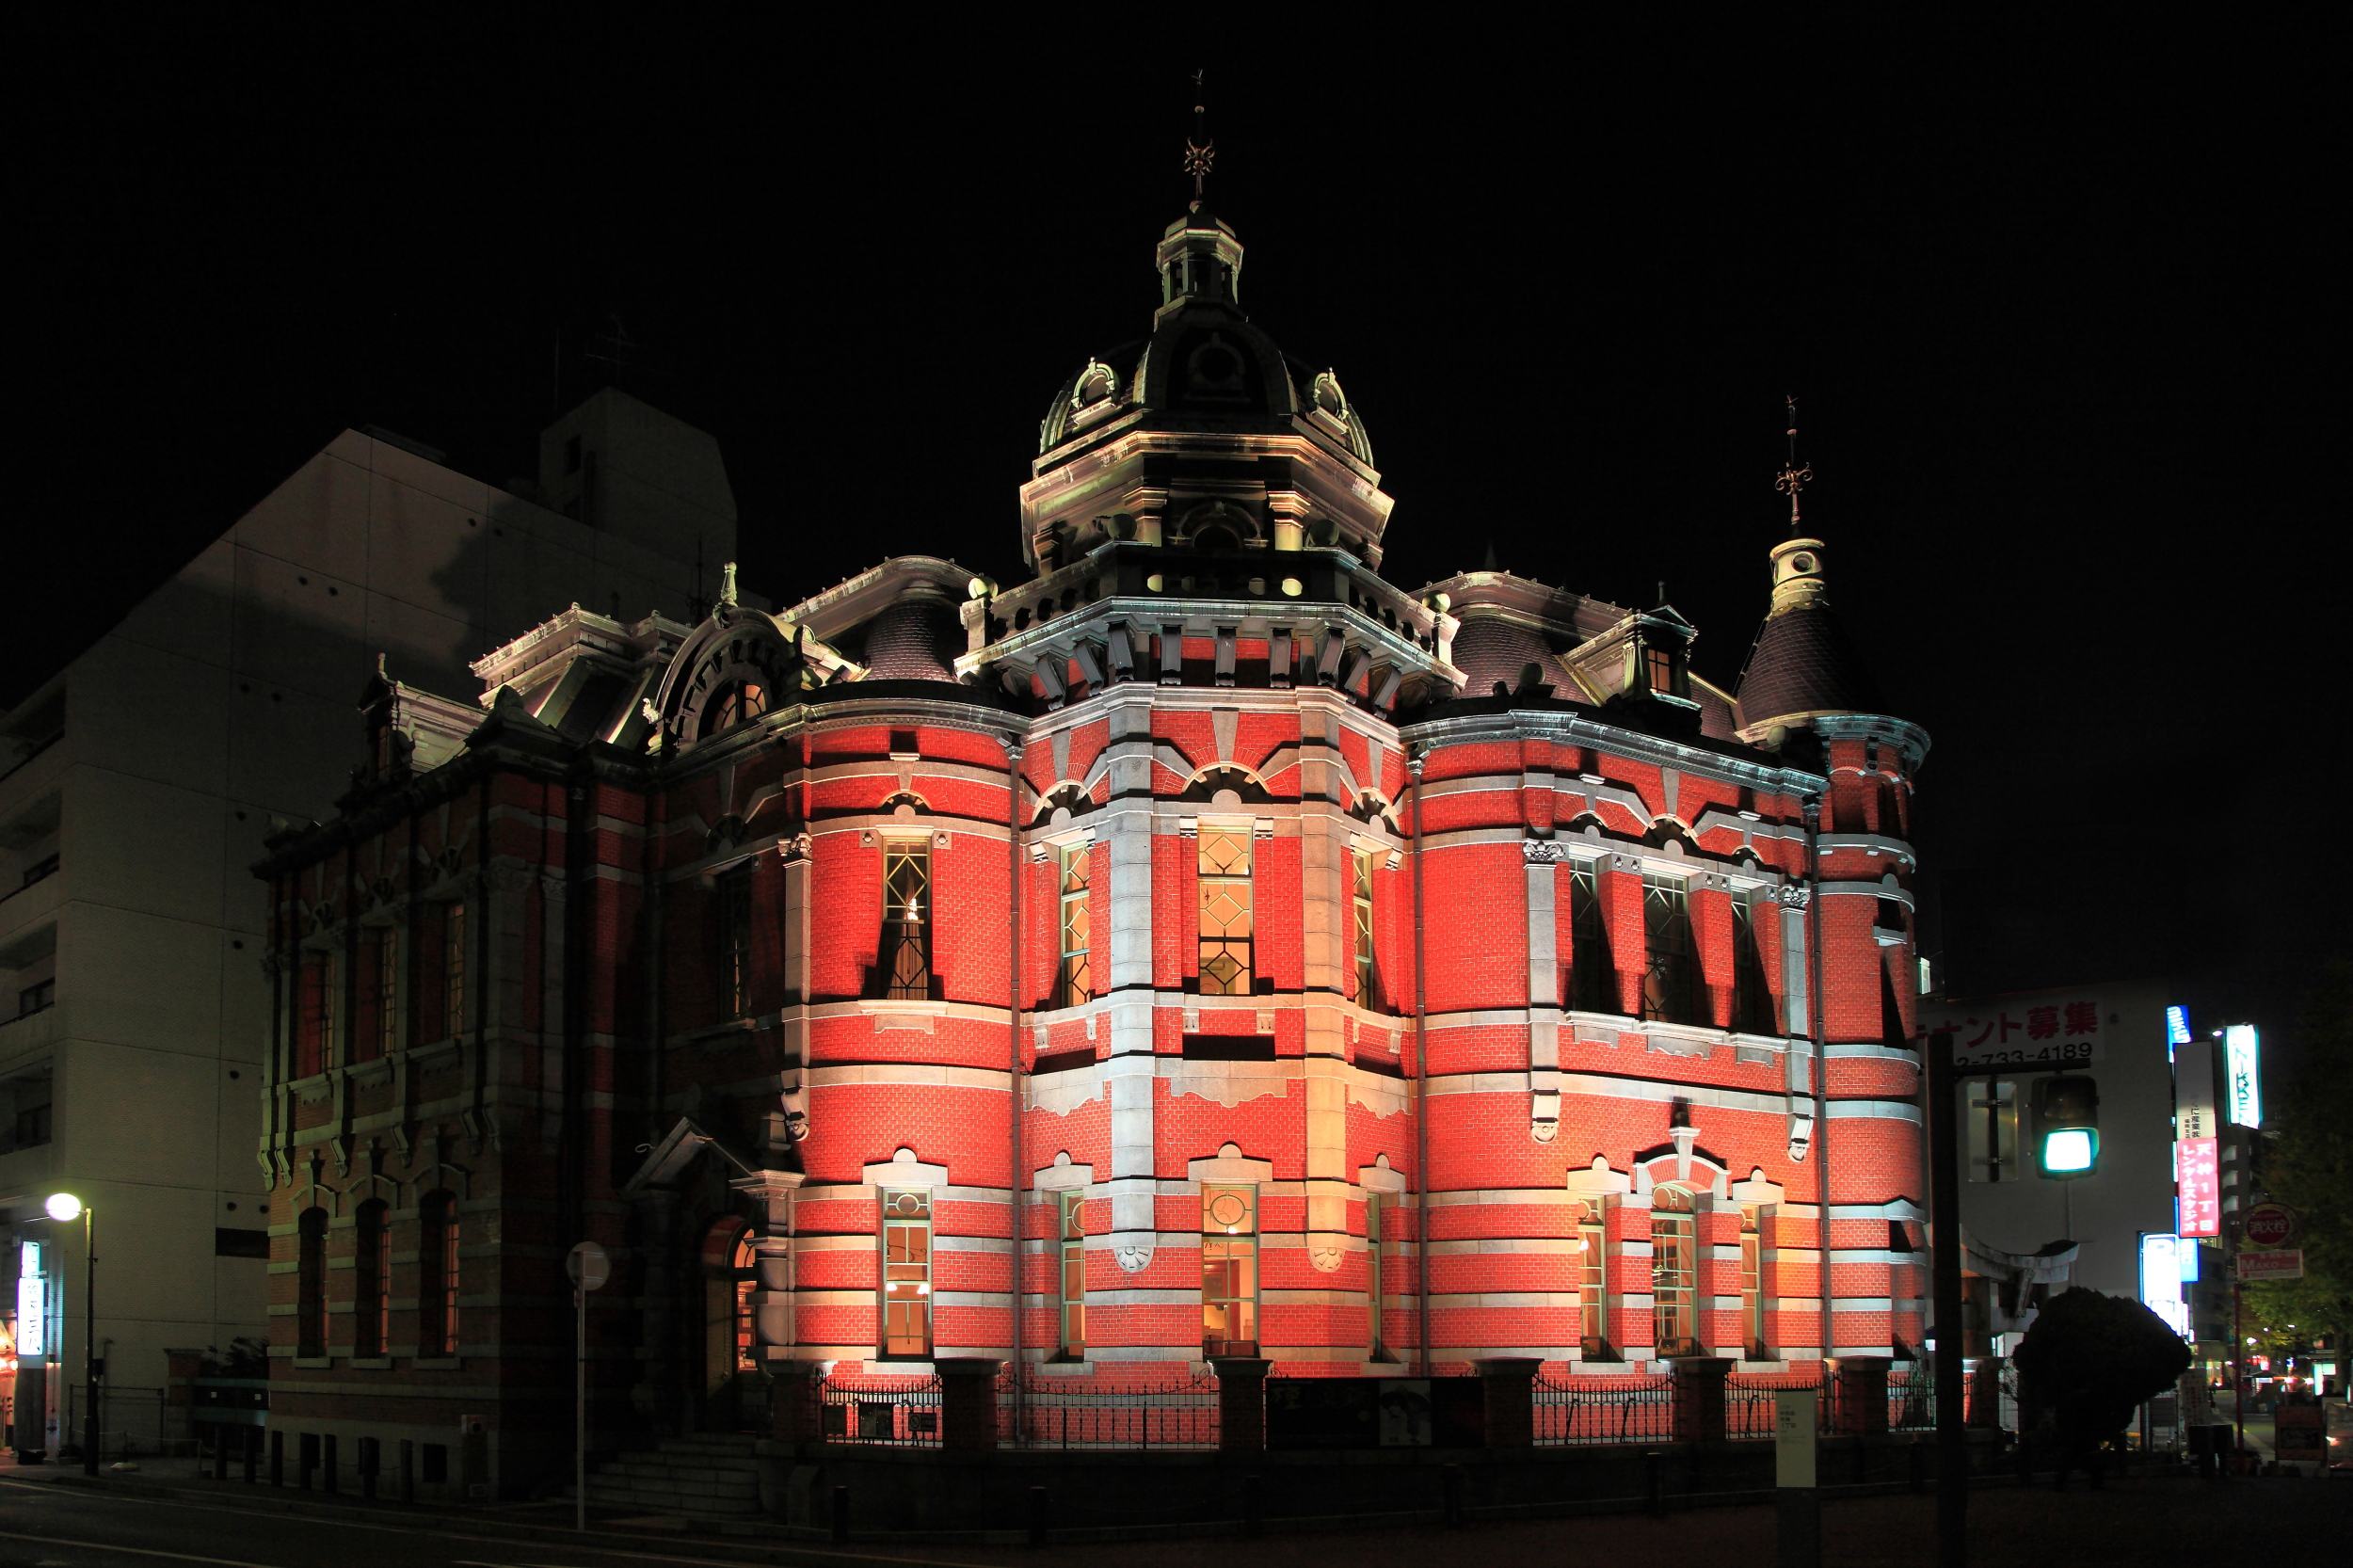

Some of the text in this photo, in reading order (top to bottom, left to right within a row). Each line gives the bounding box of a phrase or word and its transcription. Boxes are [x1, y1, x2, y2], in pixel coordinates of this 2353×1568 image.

[2182, 1144, 2198, 1232] レンタルスタジオ
[2249, 1219, 2287, 1235] 消火栓
[2241, 1258, 2279, 1272] MAKO
